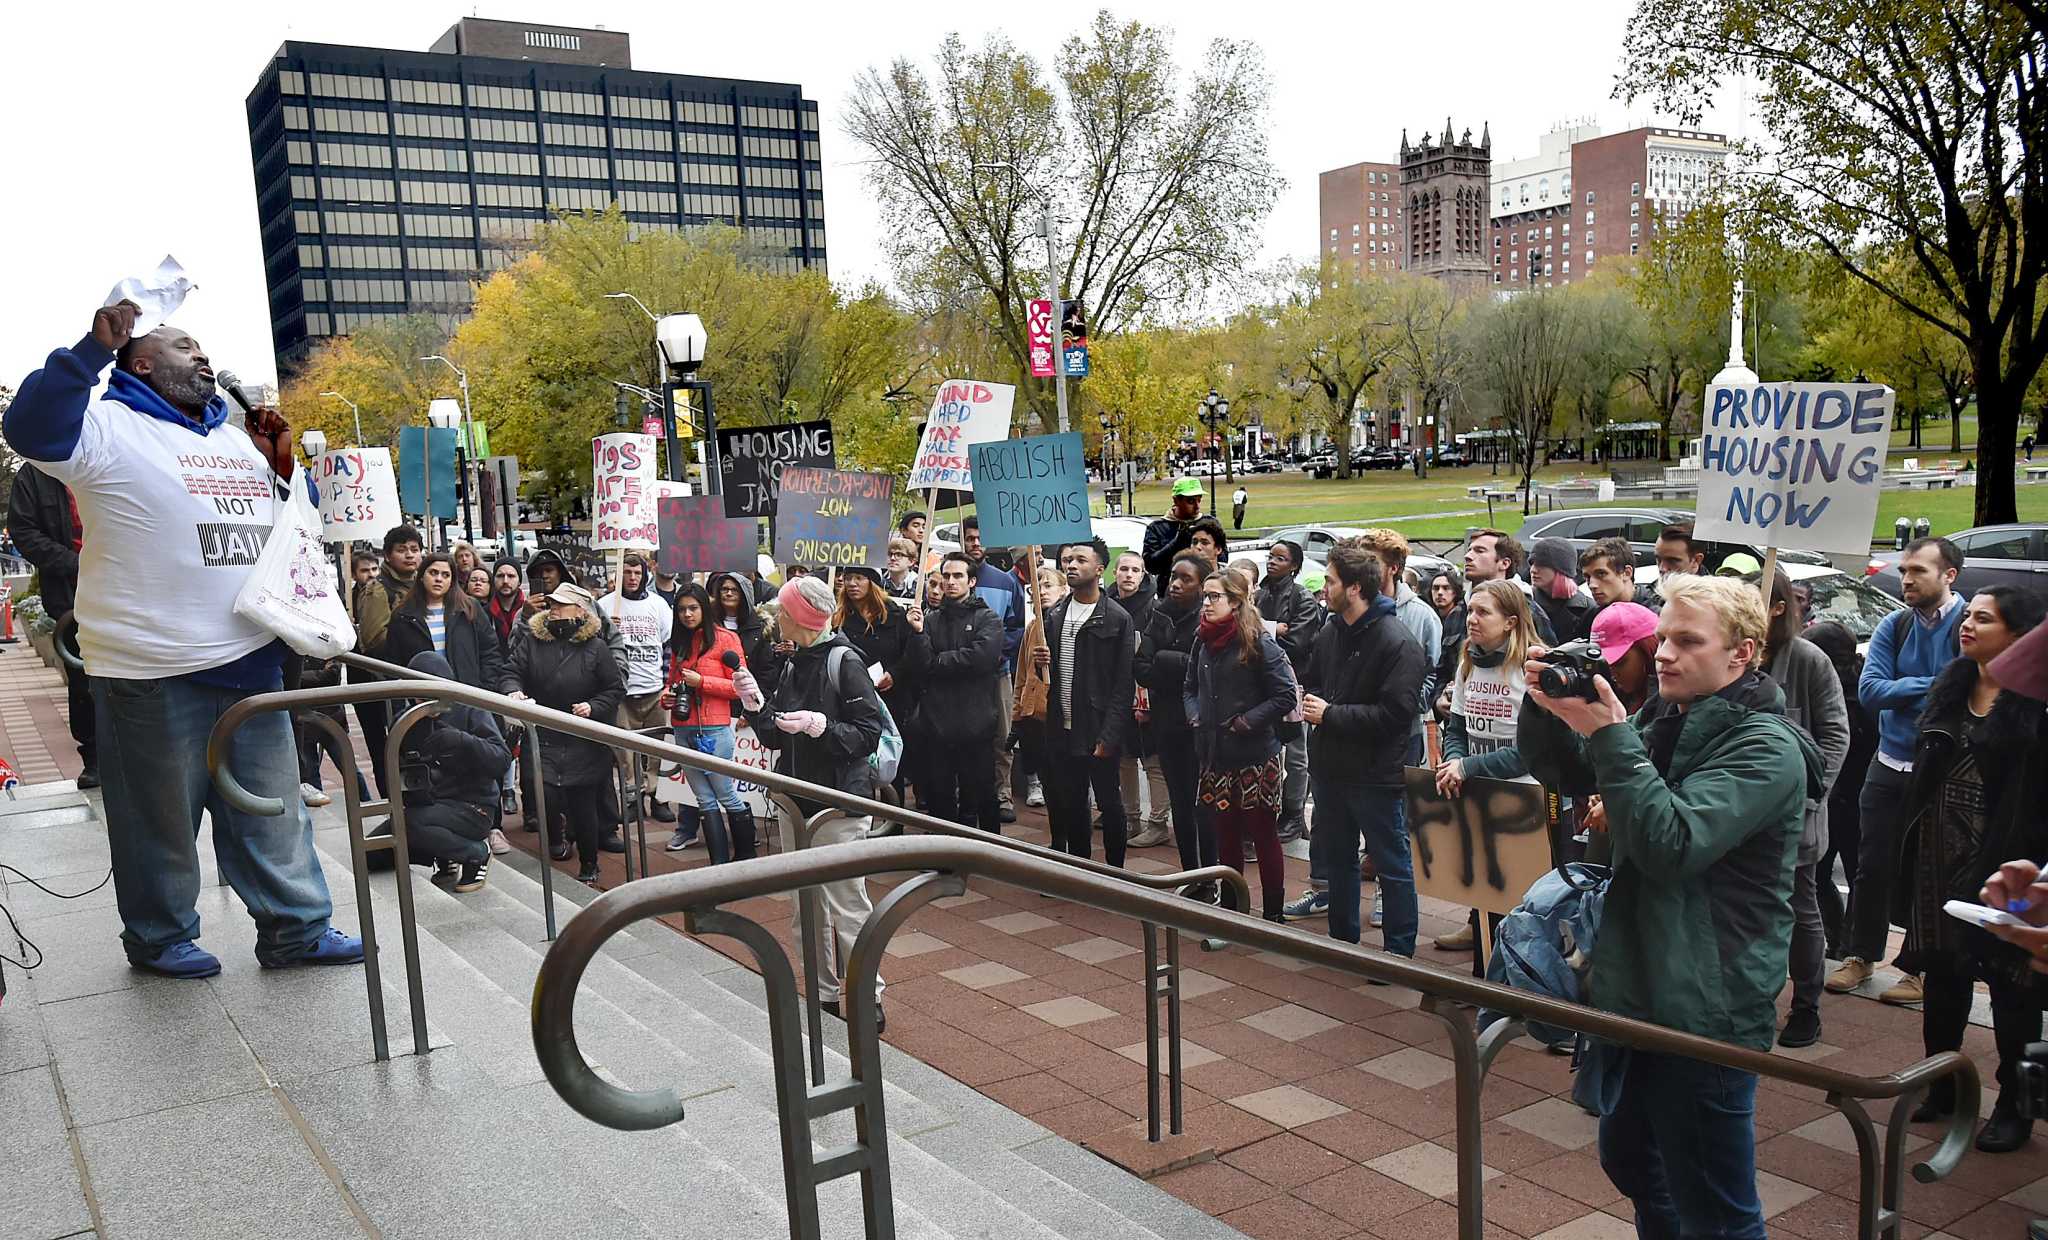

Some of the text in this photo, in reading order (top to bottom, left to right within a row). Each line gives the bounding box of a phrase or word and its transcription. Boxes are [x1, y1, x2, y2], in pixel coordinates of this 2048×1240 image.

[938, 384, 993, 404] UND
[1711, 386, 1885, 434] PROVIDE
[730, 425, 832, 460] HOUSING
[928, 426, 961, 441] TAX
[925, 441, 957, 454] YALE
[177, 455, 254, 471] HOUSING
[1703, 434, 1878, 485] HOUSING
[213, 497, 255, 516] NOT
[816, 497, 850, 517] NOT
[997, 490, 1083, 527] PRISONS
[1726, 486, 1831, 528] NOW
[793, 539, 867, 565] HOUSING
[630, 634, 648, 643] NOT
[1469, 682, 1510, 696] OUSING
[1468, 715, 1494, 733] NOT
